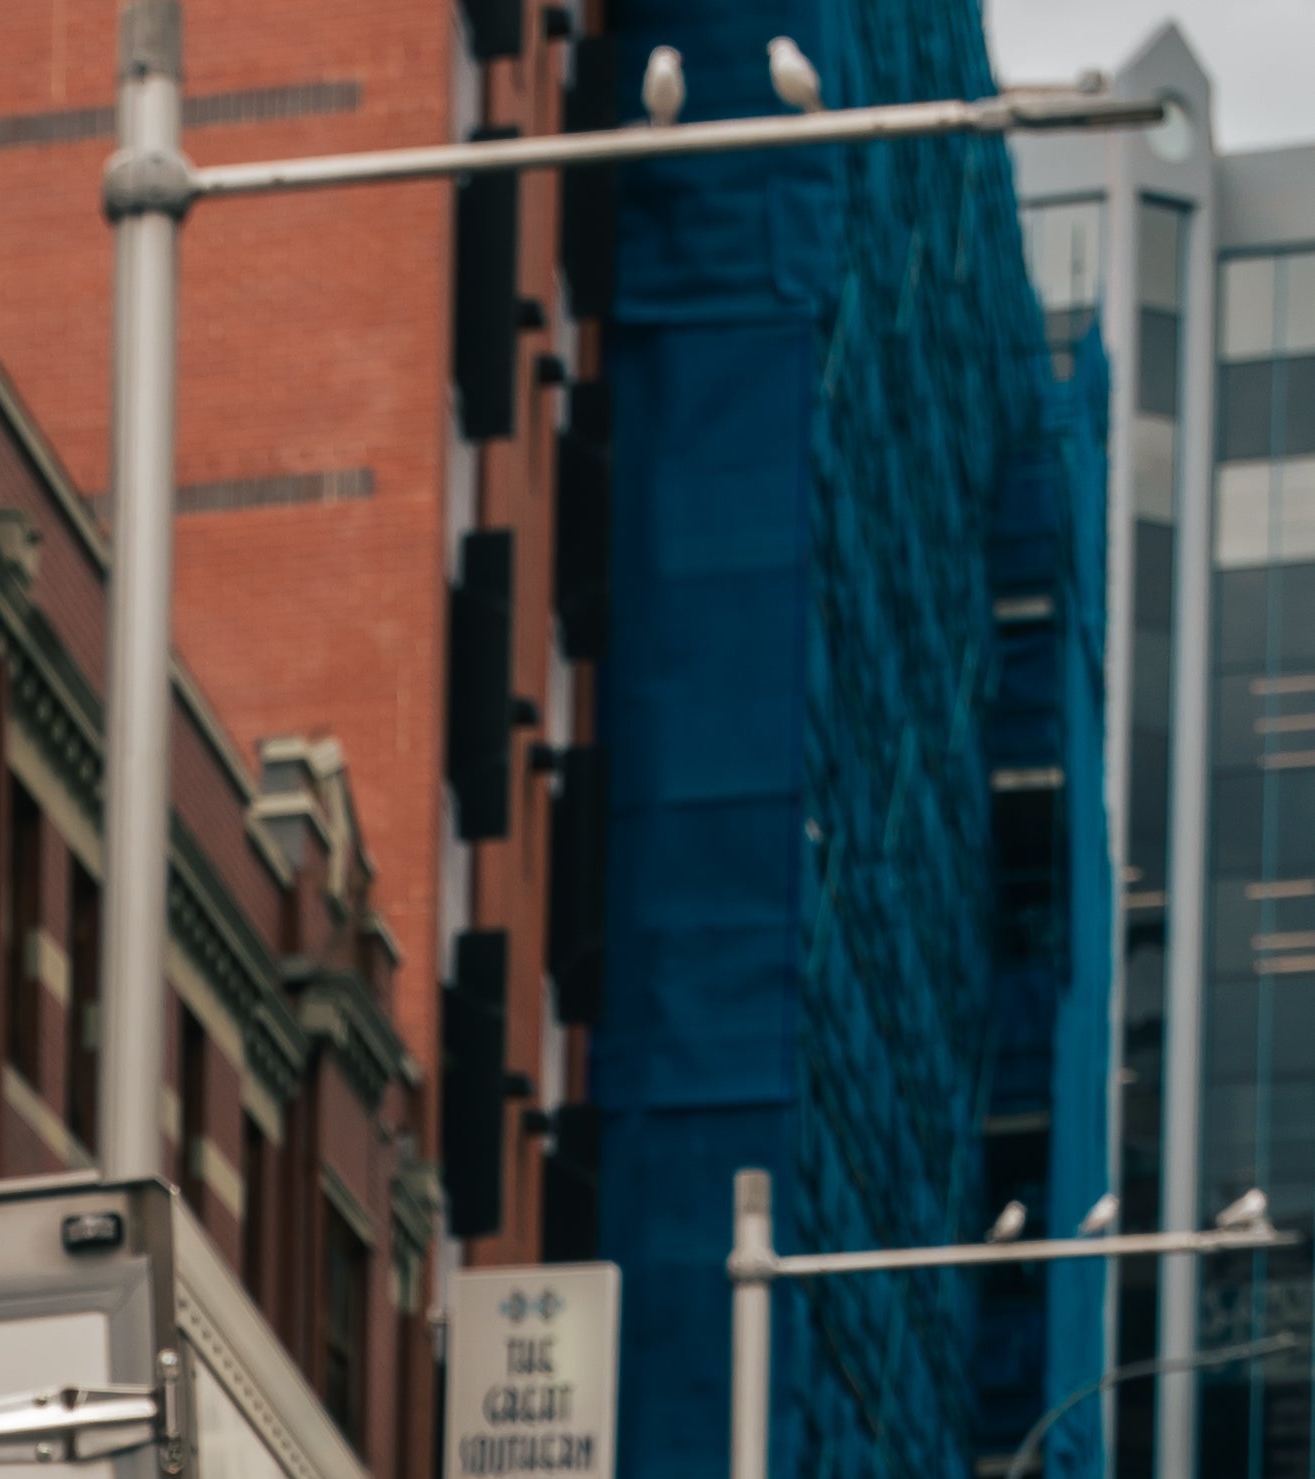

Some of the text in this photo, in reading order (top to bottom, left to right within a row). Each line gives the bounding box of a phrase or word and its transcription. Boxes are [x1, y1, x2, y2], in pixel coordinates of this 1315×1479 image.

[506, 1336, 556, 1376] THE
[481, 1384, 576, 1428] GREAT
[458, 1432, 595, 1476] SOUTHERN
